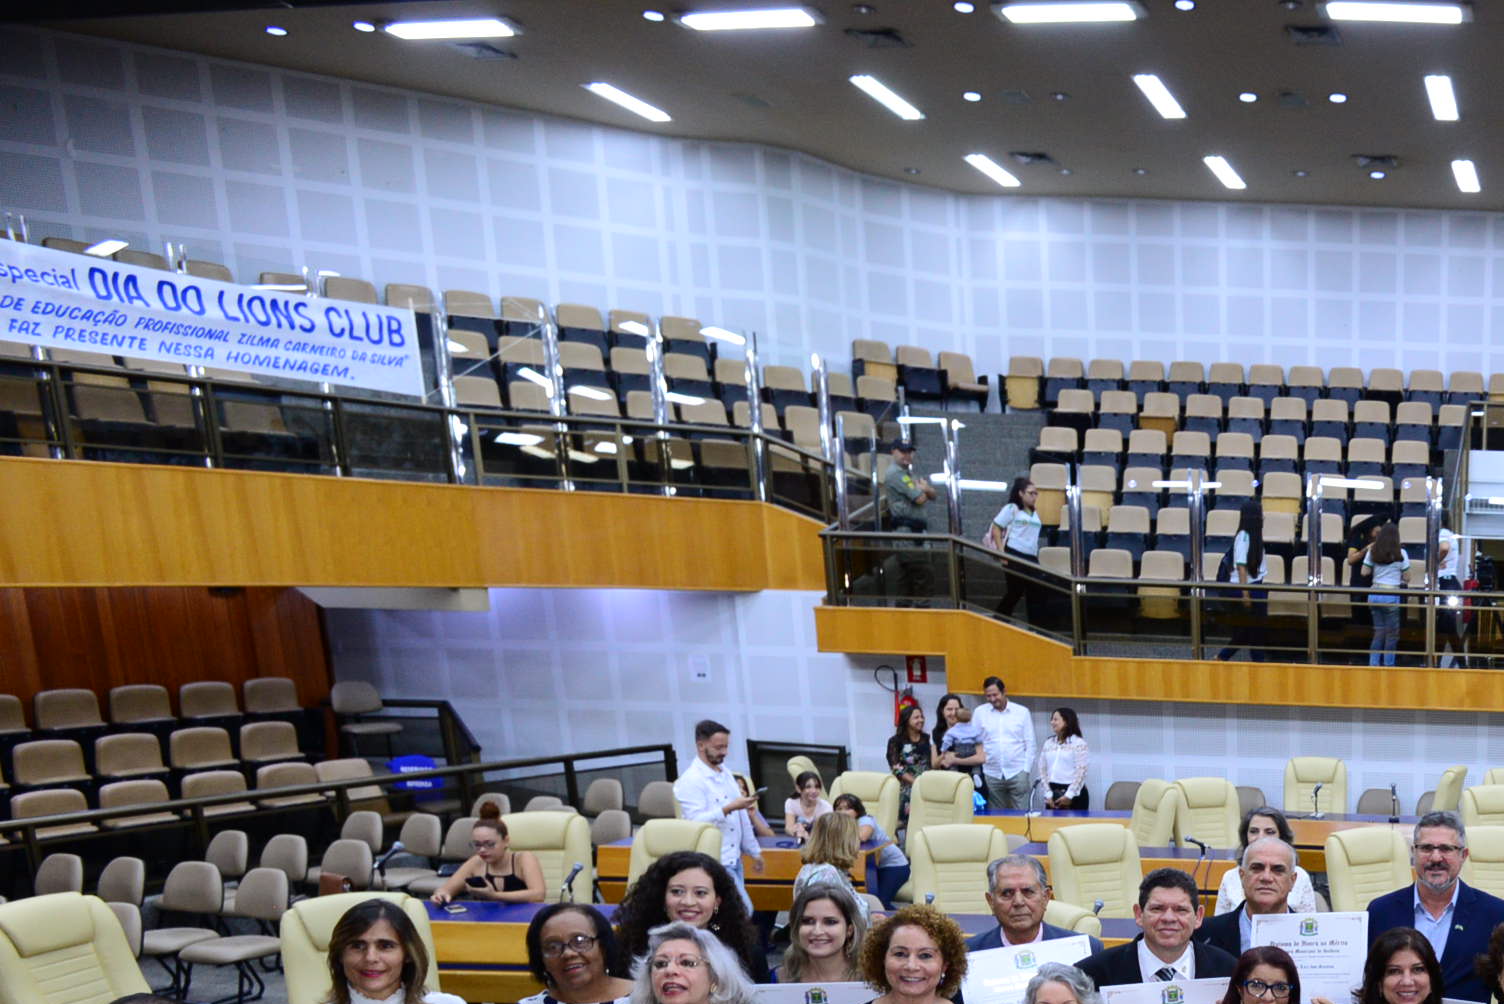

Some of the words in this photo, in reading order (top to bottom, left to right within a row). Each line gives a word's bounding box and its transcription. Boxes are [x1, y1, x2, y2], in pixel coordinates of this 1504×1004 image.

[0, 295, 26, 311] DE
[31, 300, 128, 327] EDUCAÇÃO
[135, 316, 229, 343] PROFISSIONAL
[238, 332, 281, 351] ZILMA
[284, 341, 346, 360] CARNEIRO
[351, 350, 367, 362] DA
[88, 267, 150, 308] DIA
[157, 280, 206, 316] DO
[218, 290, 316, 333] LIONS
[324, 306, 405, 348] CLUB
[8, 318, 42, 337] FAZ
[53, 325, 148, 351] PRESENTE
[159, 341, 215, 360] NESSA
[226, 350, 356, 380] HOMENAGEM.
